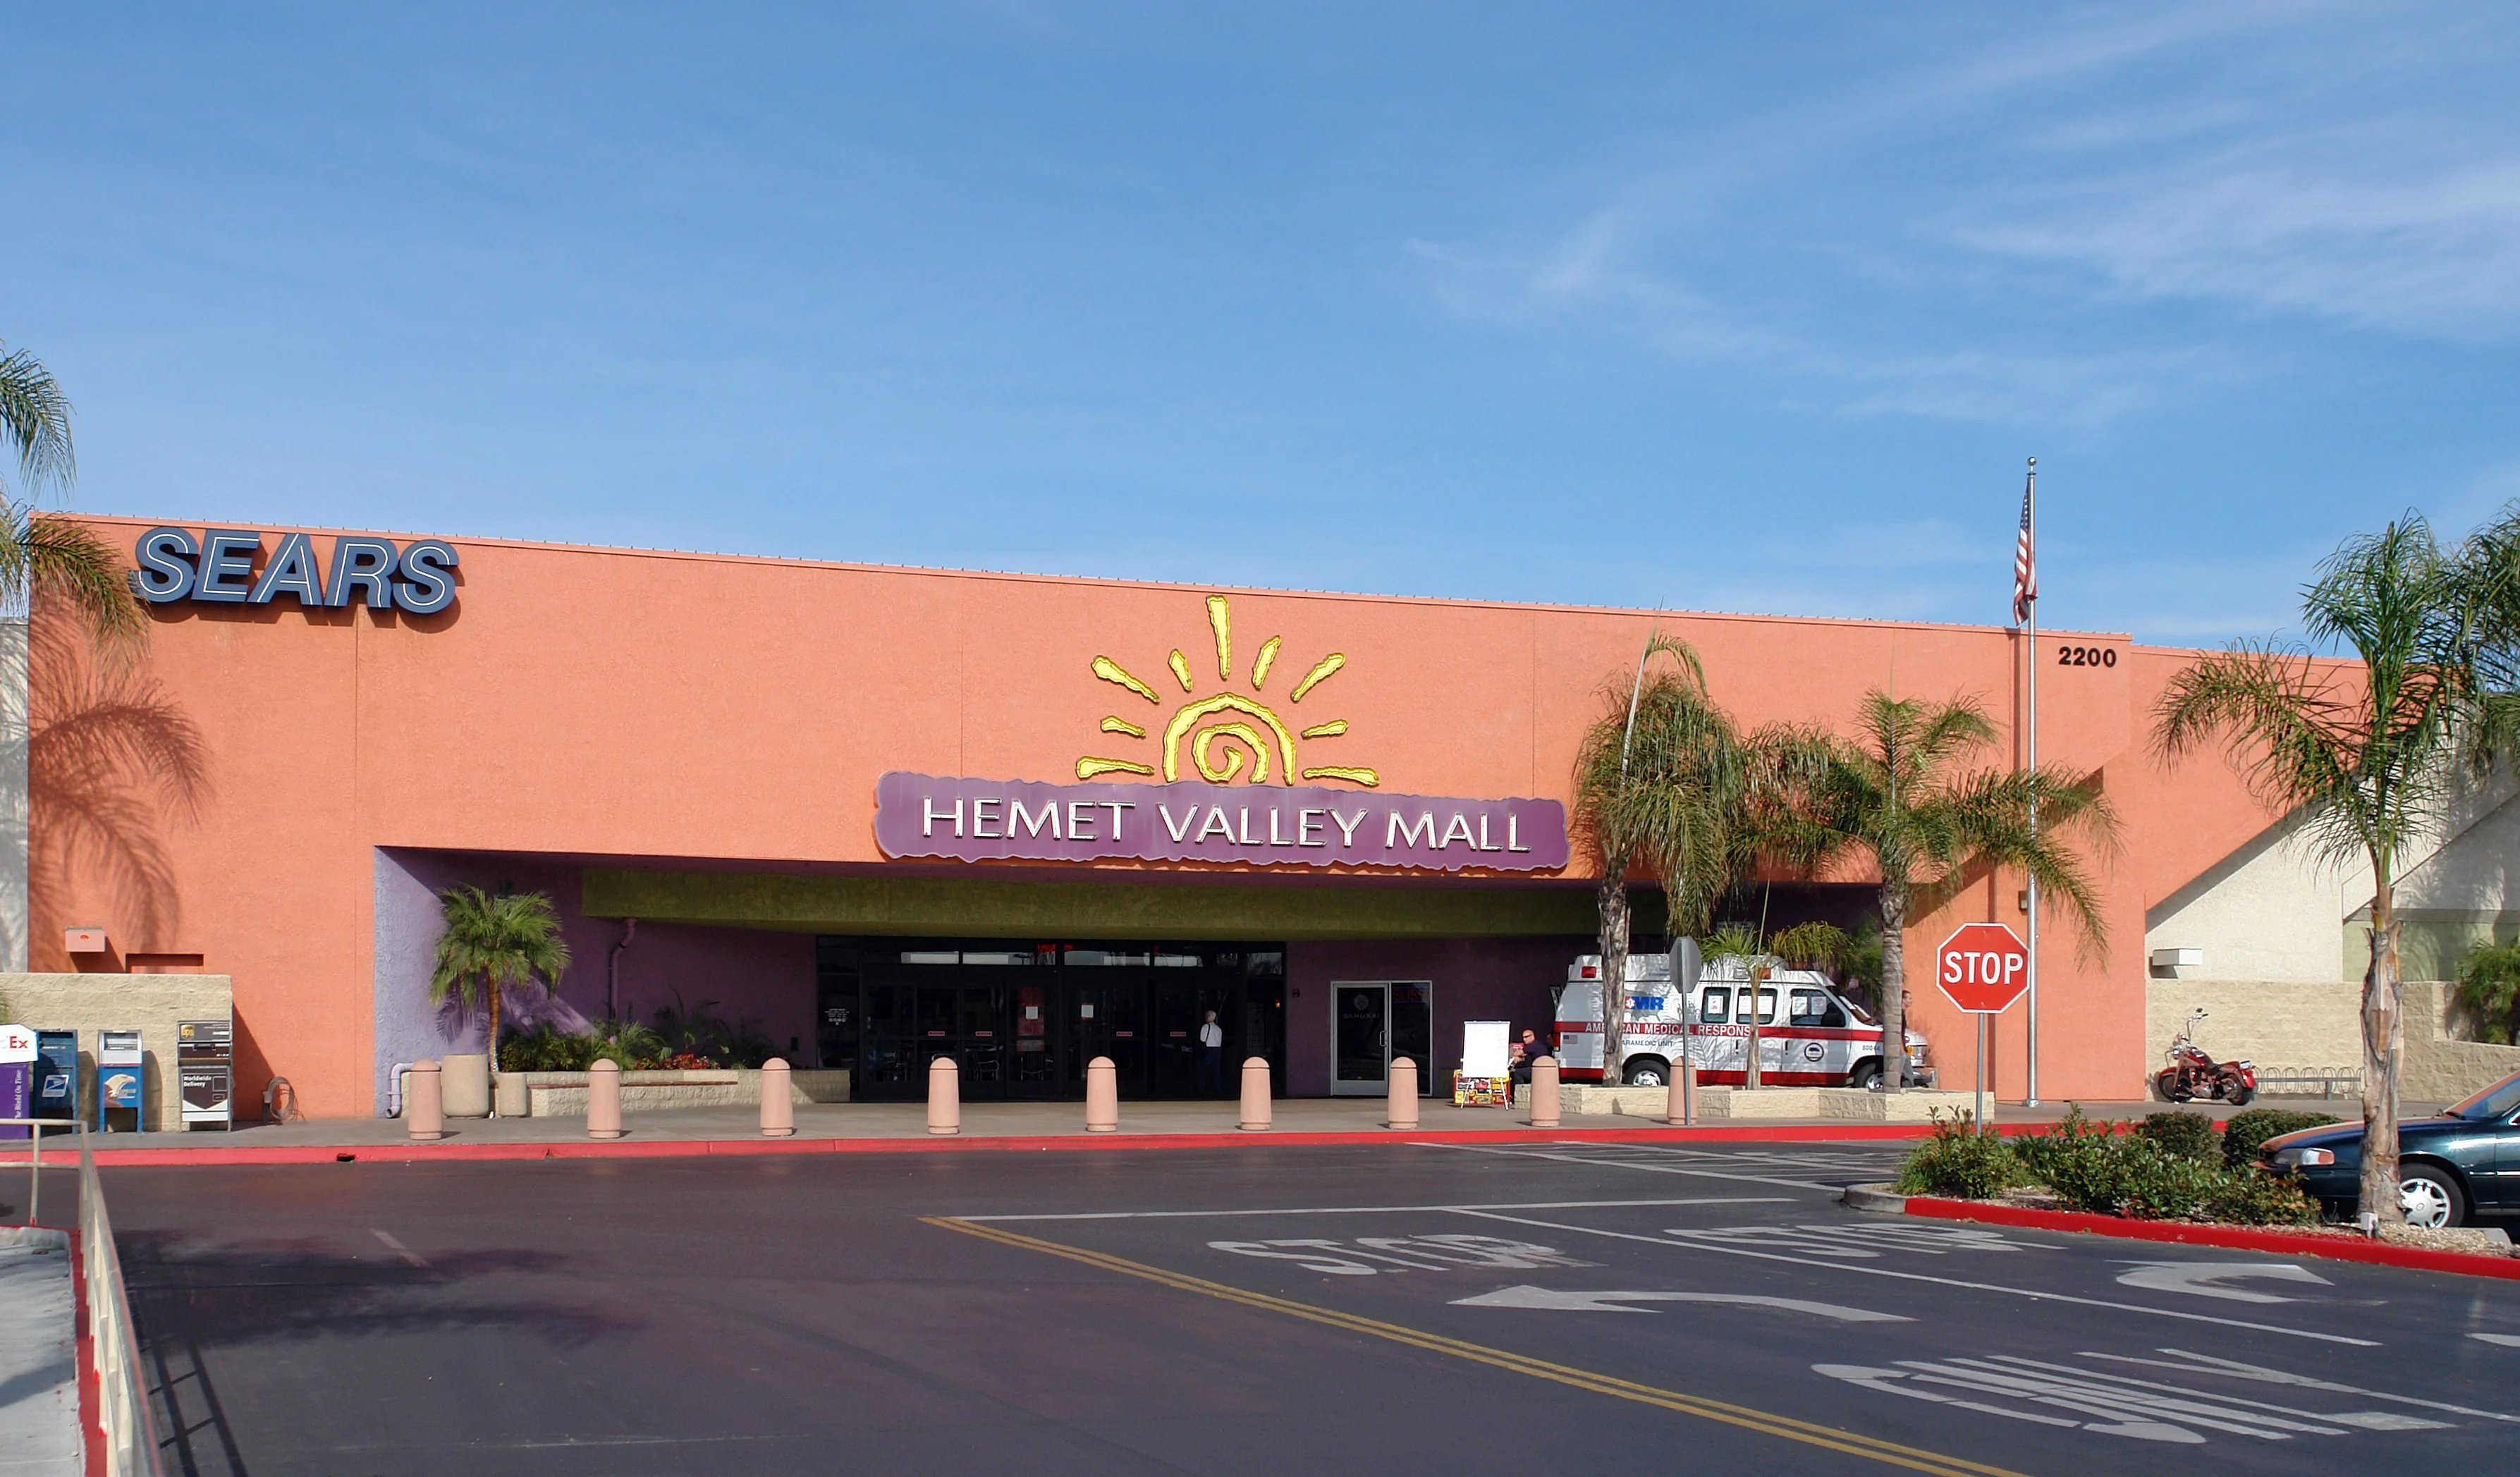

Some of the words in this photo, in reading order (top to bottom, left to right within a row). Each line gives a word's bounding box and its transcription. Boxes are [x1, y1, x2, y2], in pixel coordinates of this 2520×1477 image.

[129, 526, 460, 614] SEARS
[2058, 646, 2117, 668] 2200
[923, 797, 1136, 840] HEMET
[1157, 803, 1368, 846] VALLEY
[1386, 811, 1532, 851] MALL
[1944, 951, 2024, 985] STOP
[1698, 1025, 1751, 1037] RESPONS
[15, 1085, 22, 1093] On
[1206, 1234, 1609, 1275] STOP
[1663, 1223, 2069, 1258] STOP
[1810, 1348, 2520, 1444] ONLY
